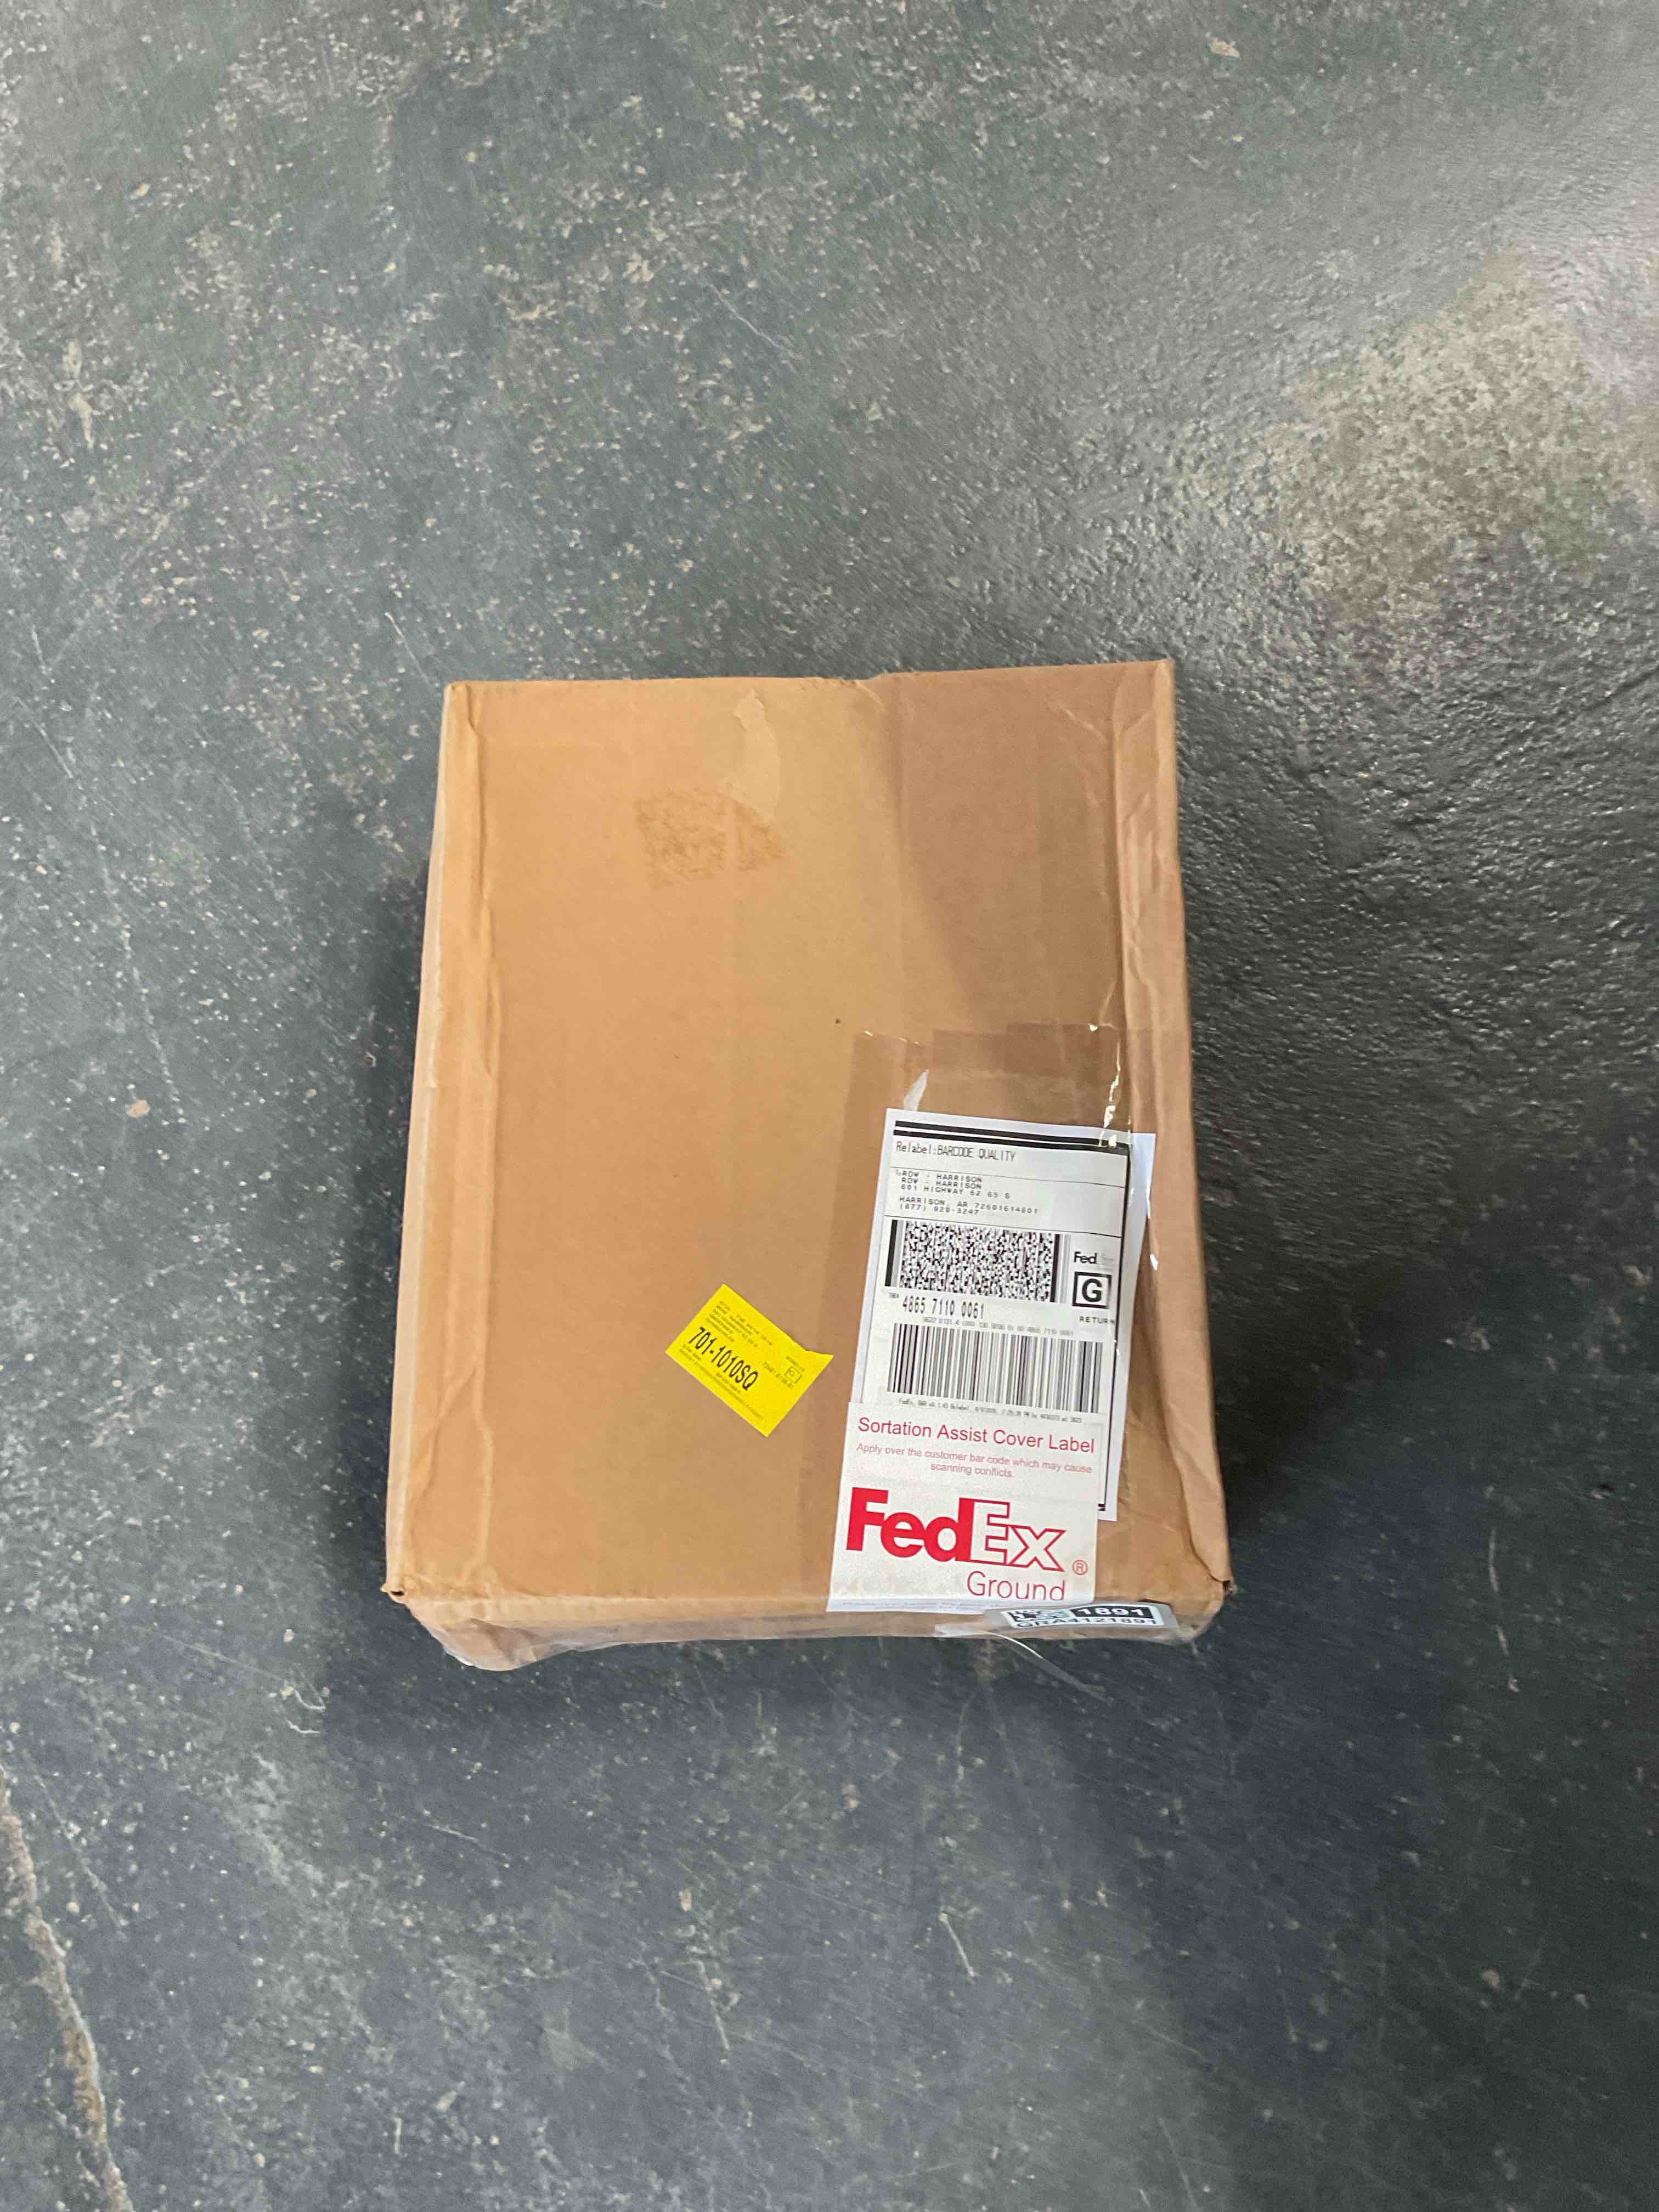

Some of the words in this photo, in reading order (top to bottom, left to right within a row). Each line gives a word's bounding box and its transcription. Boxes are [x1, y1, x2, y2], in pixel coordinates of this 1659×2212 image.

[978, 1149, 1015, 1162] QUALITY
[924, 1185, 964, 1194] HIGHWAY
[936, 1173, 982, 1183] HARRISON
[936, 1180, 982, 1189] HARRISON
[1081, 1278, 1103, 1302] G
[902, 1295, 926, 1313] 4865
[932, 1298, 955, 1316] 7110
[961, 1301, 984, 1319] 0061
[689, 1326, 758, 1391] 701-1010SQ
[857, 1417, 932, 1438] Sortation
[936, 1424, 988, 1443] Assist
[992, 1430, 1044, 1449] Cover
[1048, 1435, 1095, 1453] Label
[856, 1443, 882, 1455] Apply
[885, 1447, 905, 1456] over
[907, 1447, 922, 1457] the
[924, 1449, 967, 1462] customer
[969, 1453, 985, 1463] bar
[987, 1455, 1010, 1466] code
[1013, 1457, 1040, 1469] which
[1042, 1462, 1062, 1474] may
[1064, 1464, 1092, 1474] cause
[930, 1463, 971, 1476] scanning
[846, 1487, 1066, 1572] FedEx
[967, 1571, 1065, 1601] Ground
[1078, 1607, 1145, 1616] 1891
